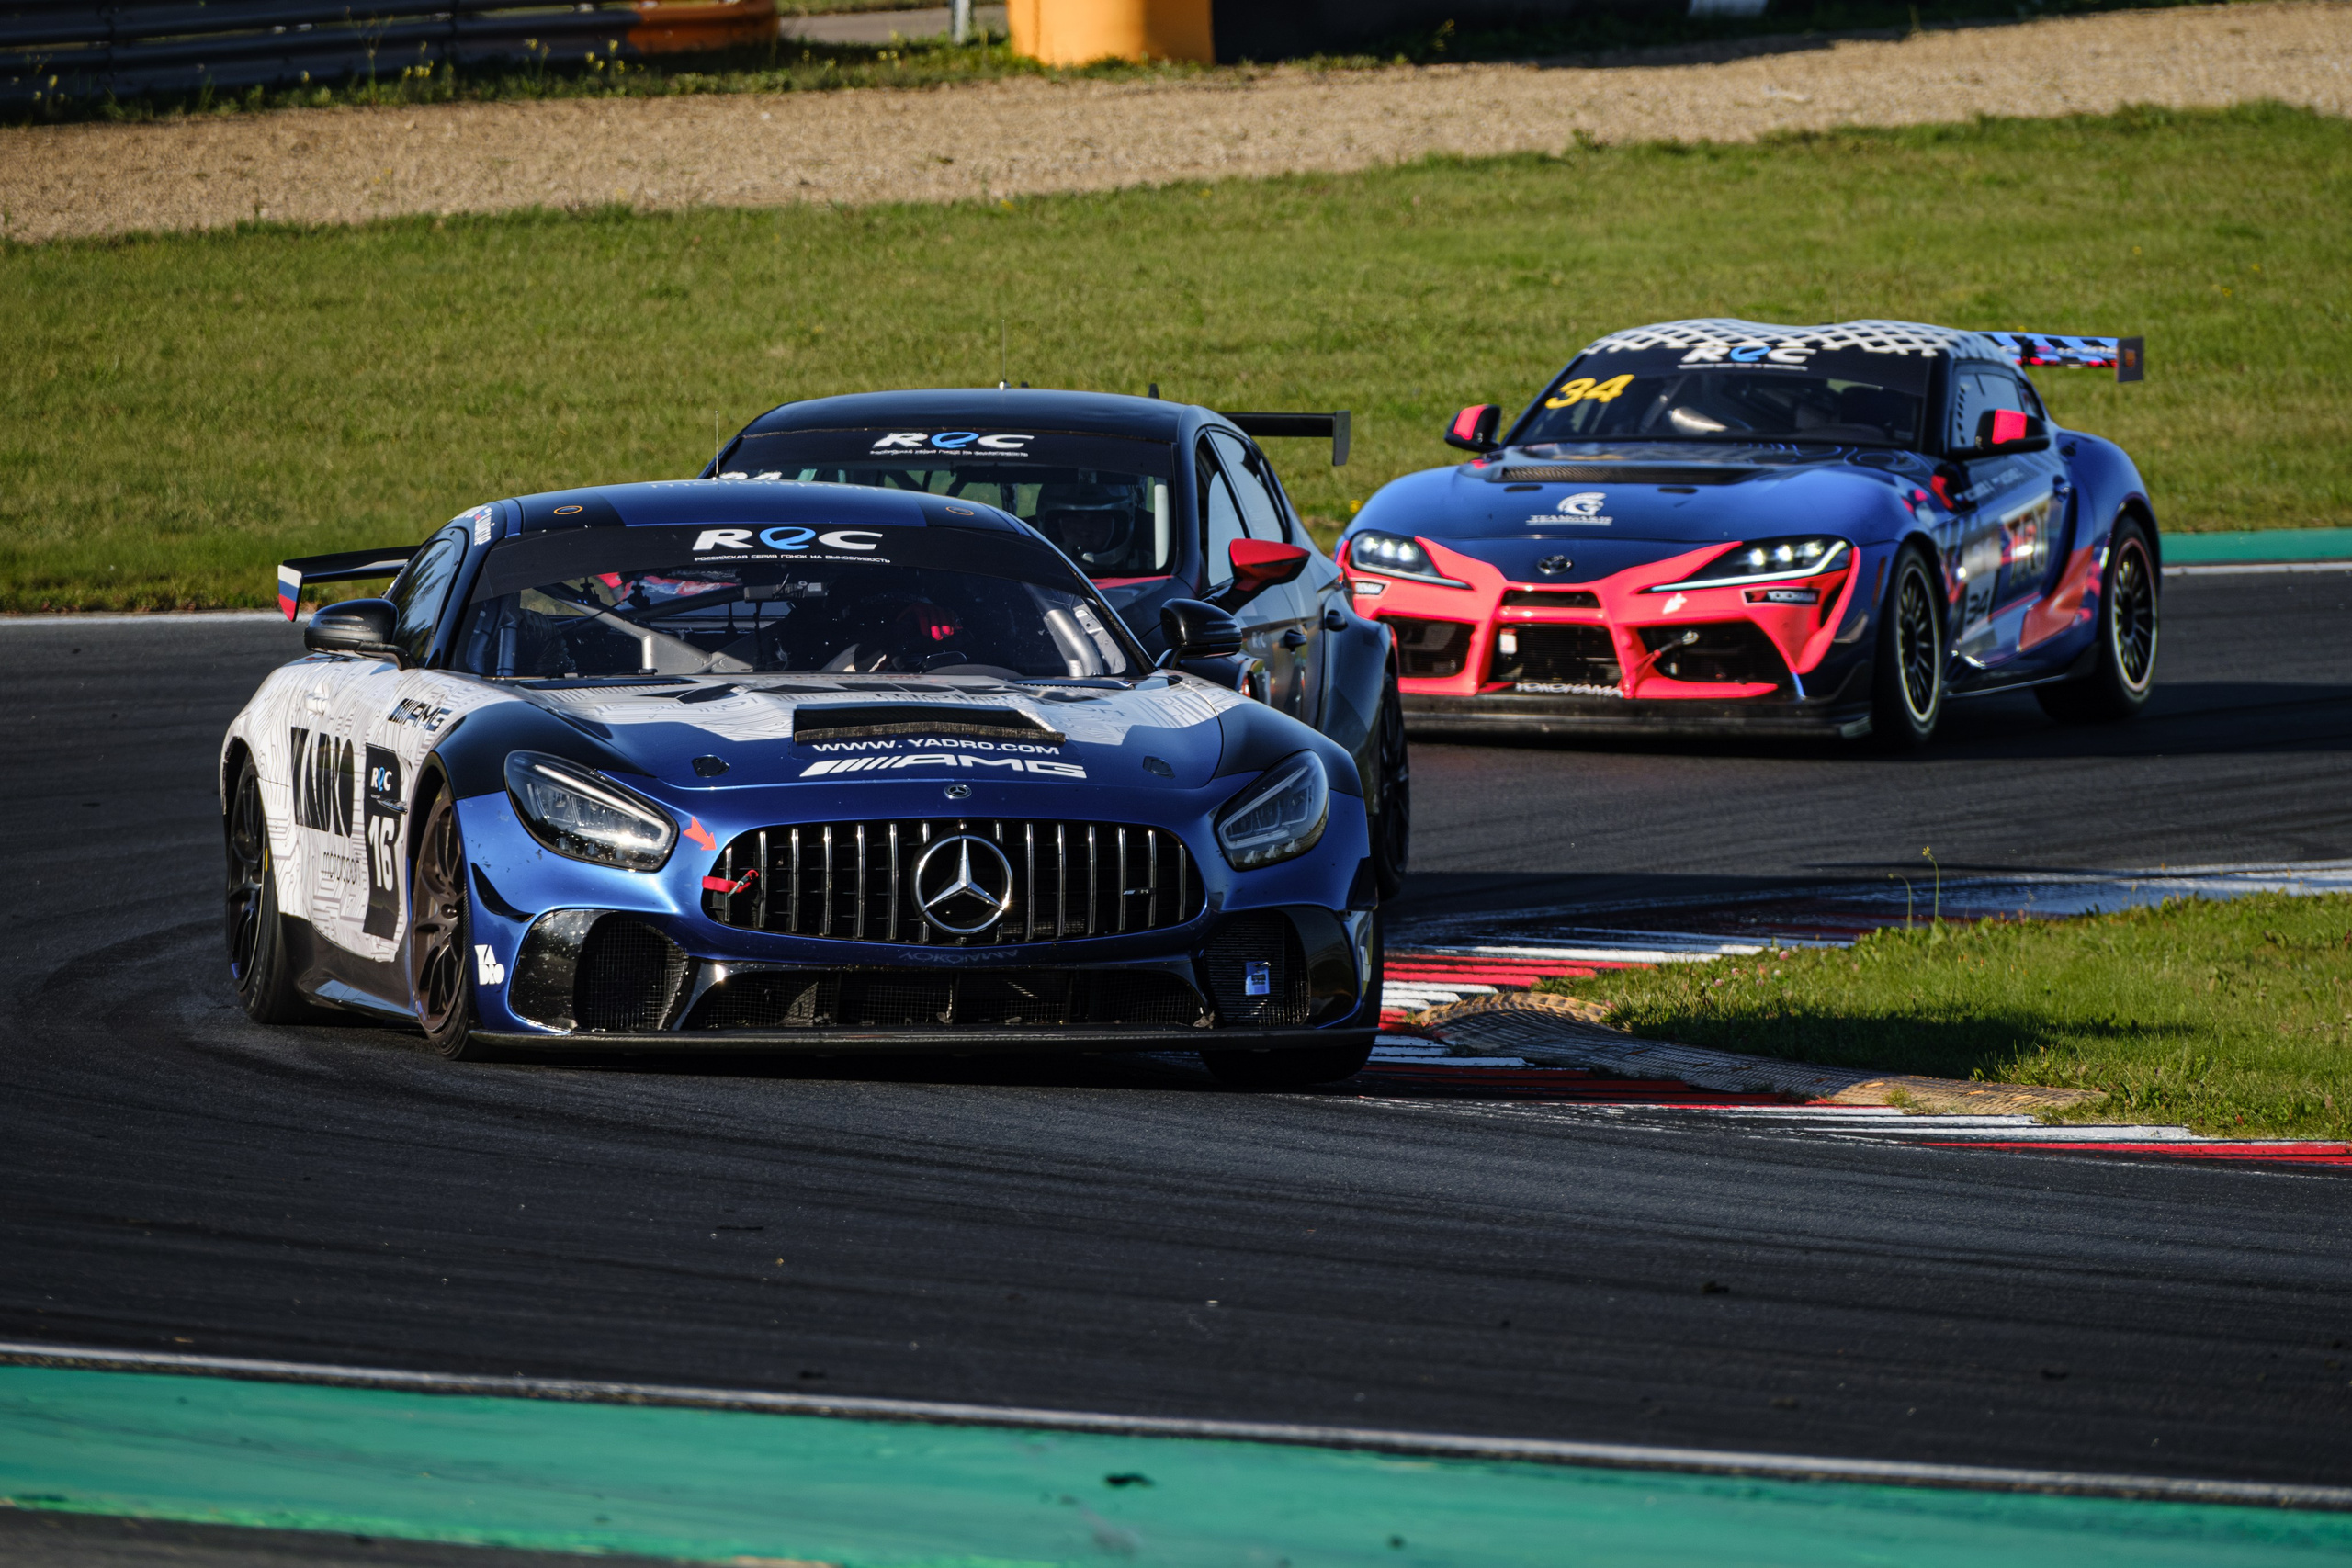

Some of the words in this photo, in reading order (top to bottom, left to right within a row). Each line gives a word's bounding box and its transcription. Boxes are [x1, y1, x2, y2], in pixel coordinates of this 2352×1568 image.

[1544, 373, 1635, 410] 34
[694, 554, 749, 562] РОССИЙСКАЯ
[825, 554, 891, 563] ВЫНОСЛИВОСТЬ
[1515, 682, 1624, 698] YOKOHAMA
[884, 754, 1087, 778] AMG
[368, 814, 395, 891] 16
